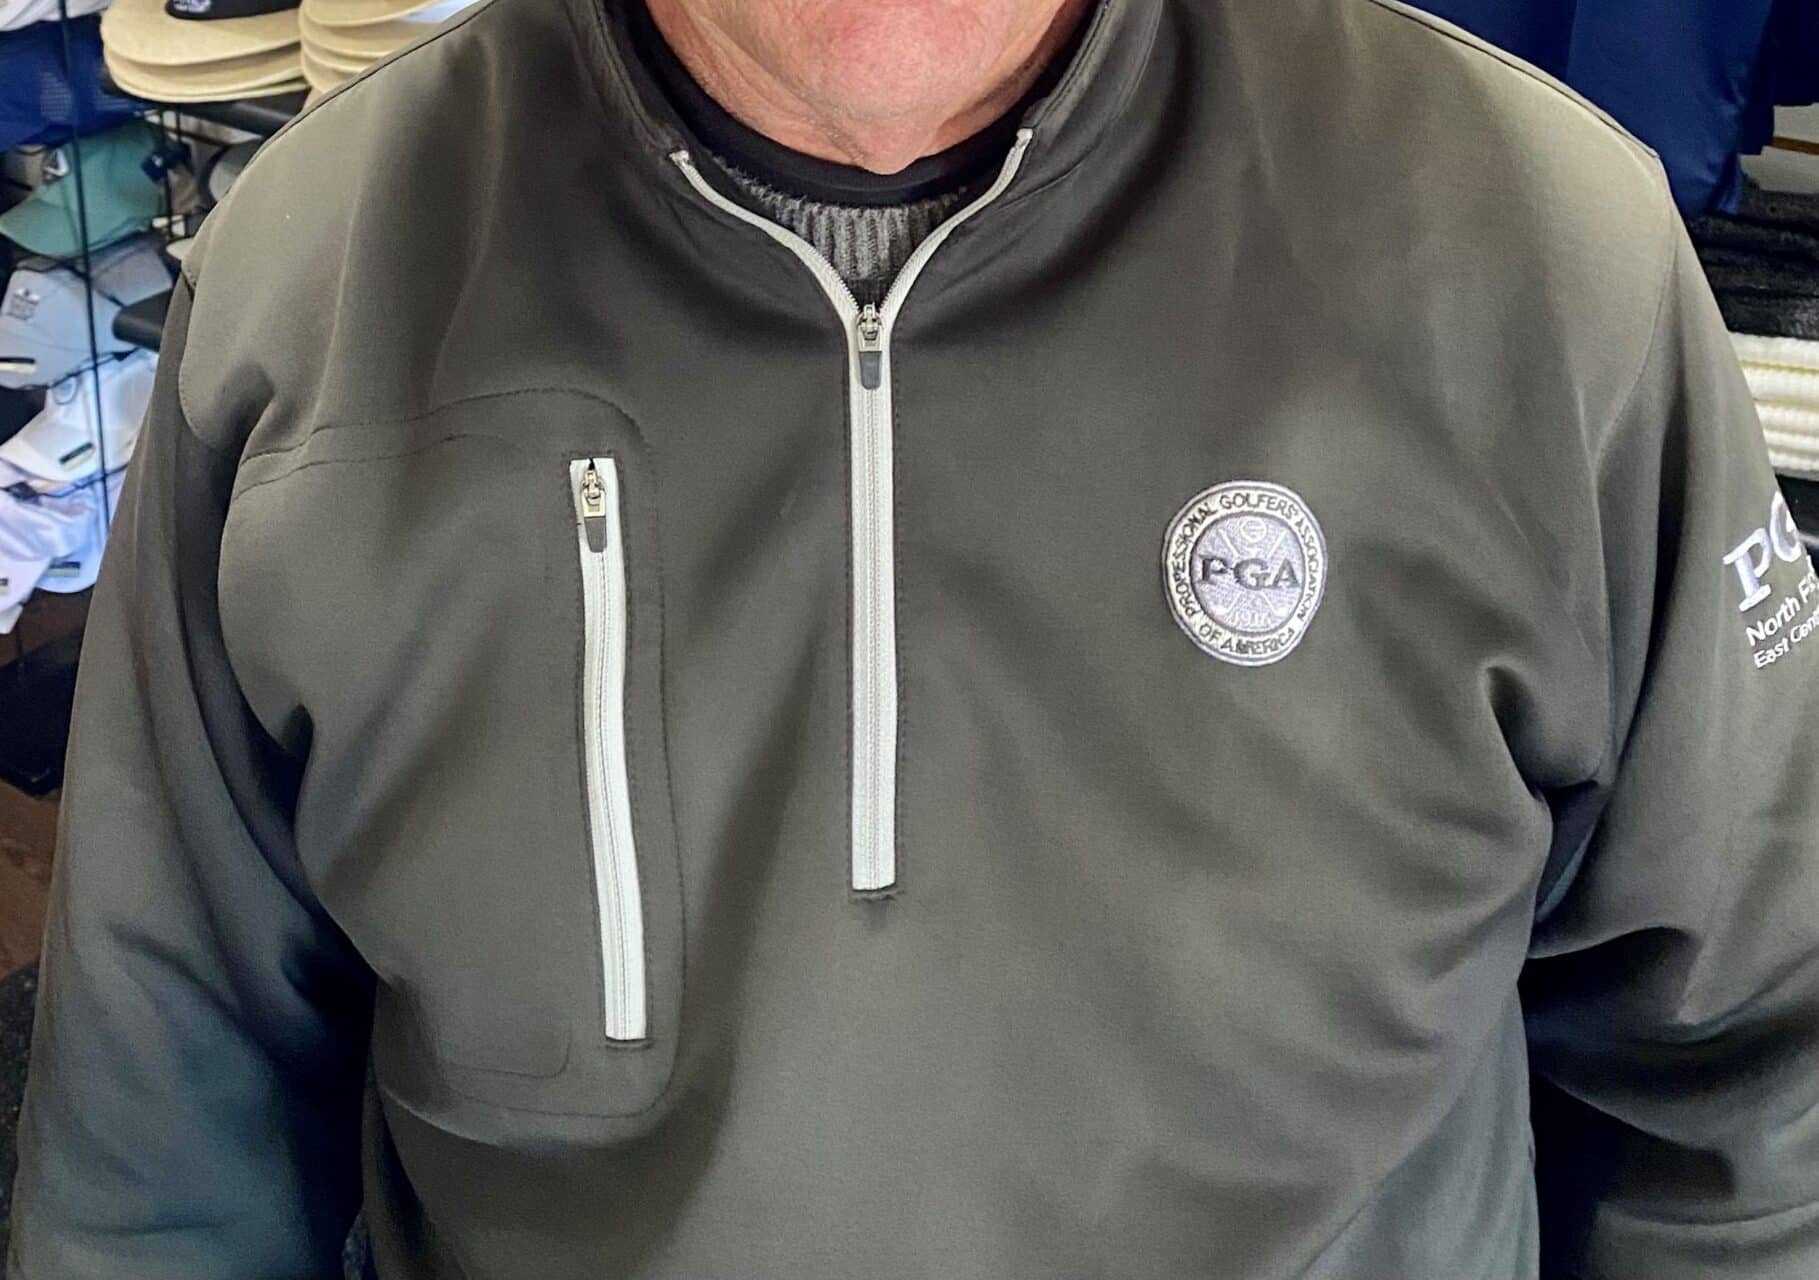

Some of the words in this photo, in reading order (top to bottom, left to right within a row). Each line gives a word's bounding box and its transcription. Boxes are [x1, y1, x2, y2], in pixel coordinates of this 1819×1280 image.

[1172, 502, 1217, 617] PROFESSIONAL
[1200, 623, 1223, 643] OF
[1221, 627, 1296, 655] AMERICA
[1746, 595, 1801, 646] North
[1753, 637, 1790, 669] East
